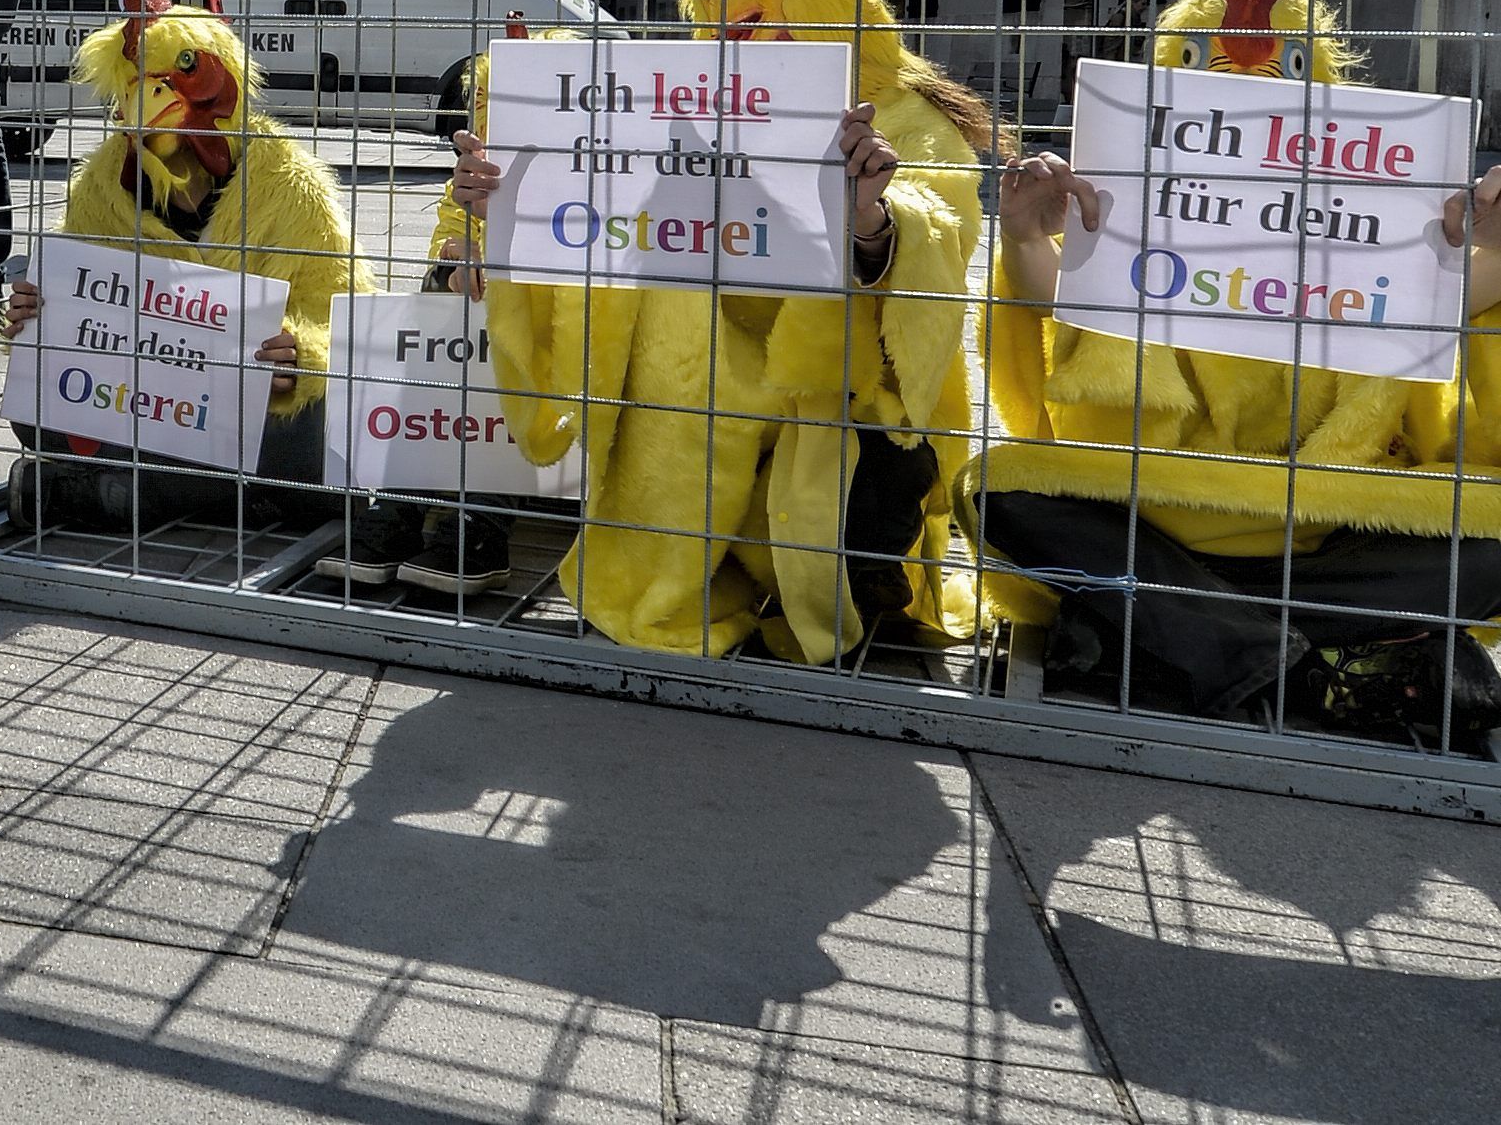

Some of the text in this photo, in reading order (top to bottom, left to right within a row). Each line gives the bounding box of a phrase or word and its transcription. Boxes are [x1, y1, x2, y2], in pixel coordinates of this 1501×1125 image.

[251, 32, 295, 52] KEN
[555, 72, 771, 117] Ich leide
[570, 136, 752, 178] für dein
[1151, 104, 1415, 178] Ich leide
[551, 200, 771, 257] Osterei
[1154, 177, 1381, 245] für dein
[72, 266, 229, 327] Ich leide
[1129, 247, 1389, 323] Osterei
[75, 318, 206, 373] für dein
[58, 367, 211, 432] Osterei
[366, 405, 516, 444] Oster
